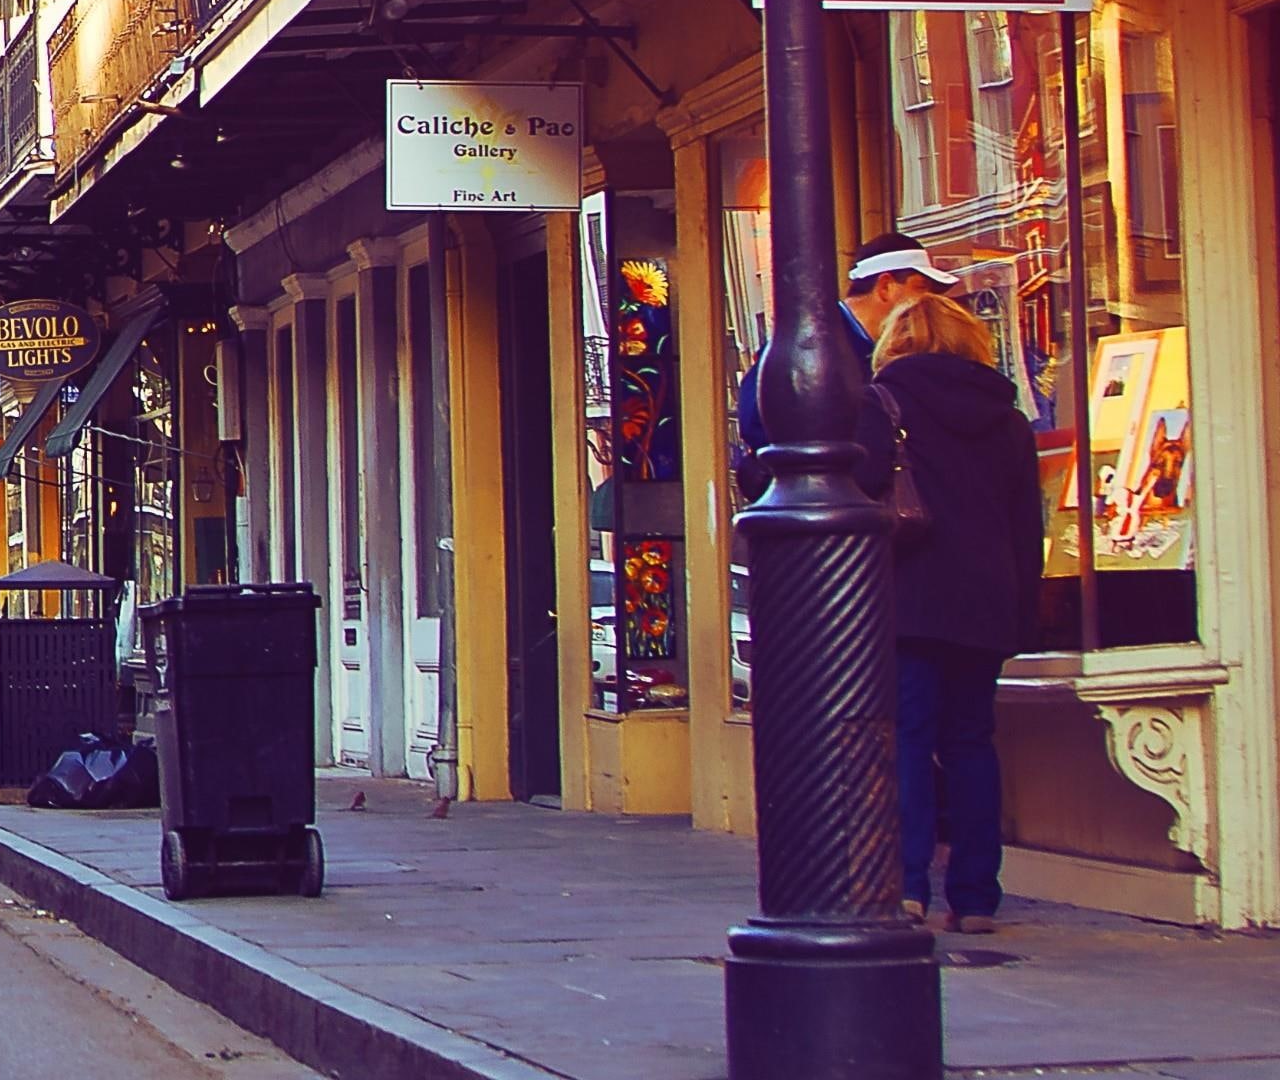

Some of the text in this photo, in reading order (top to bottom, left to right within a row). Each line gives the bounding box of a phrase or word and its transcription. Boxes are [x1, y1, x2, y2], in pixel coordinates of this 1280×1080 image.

[396, 115, 494, 138] Caliche
[528, 116, 576, 137] Pao
[453, 143, 518, 160] Gallery
[453, 190, 517, 203] Fine Art
[38, 338, 76, 346] ELECTRIC
[7, 347, 73, 368] LIGHTS
